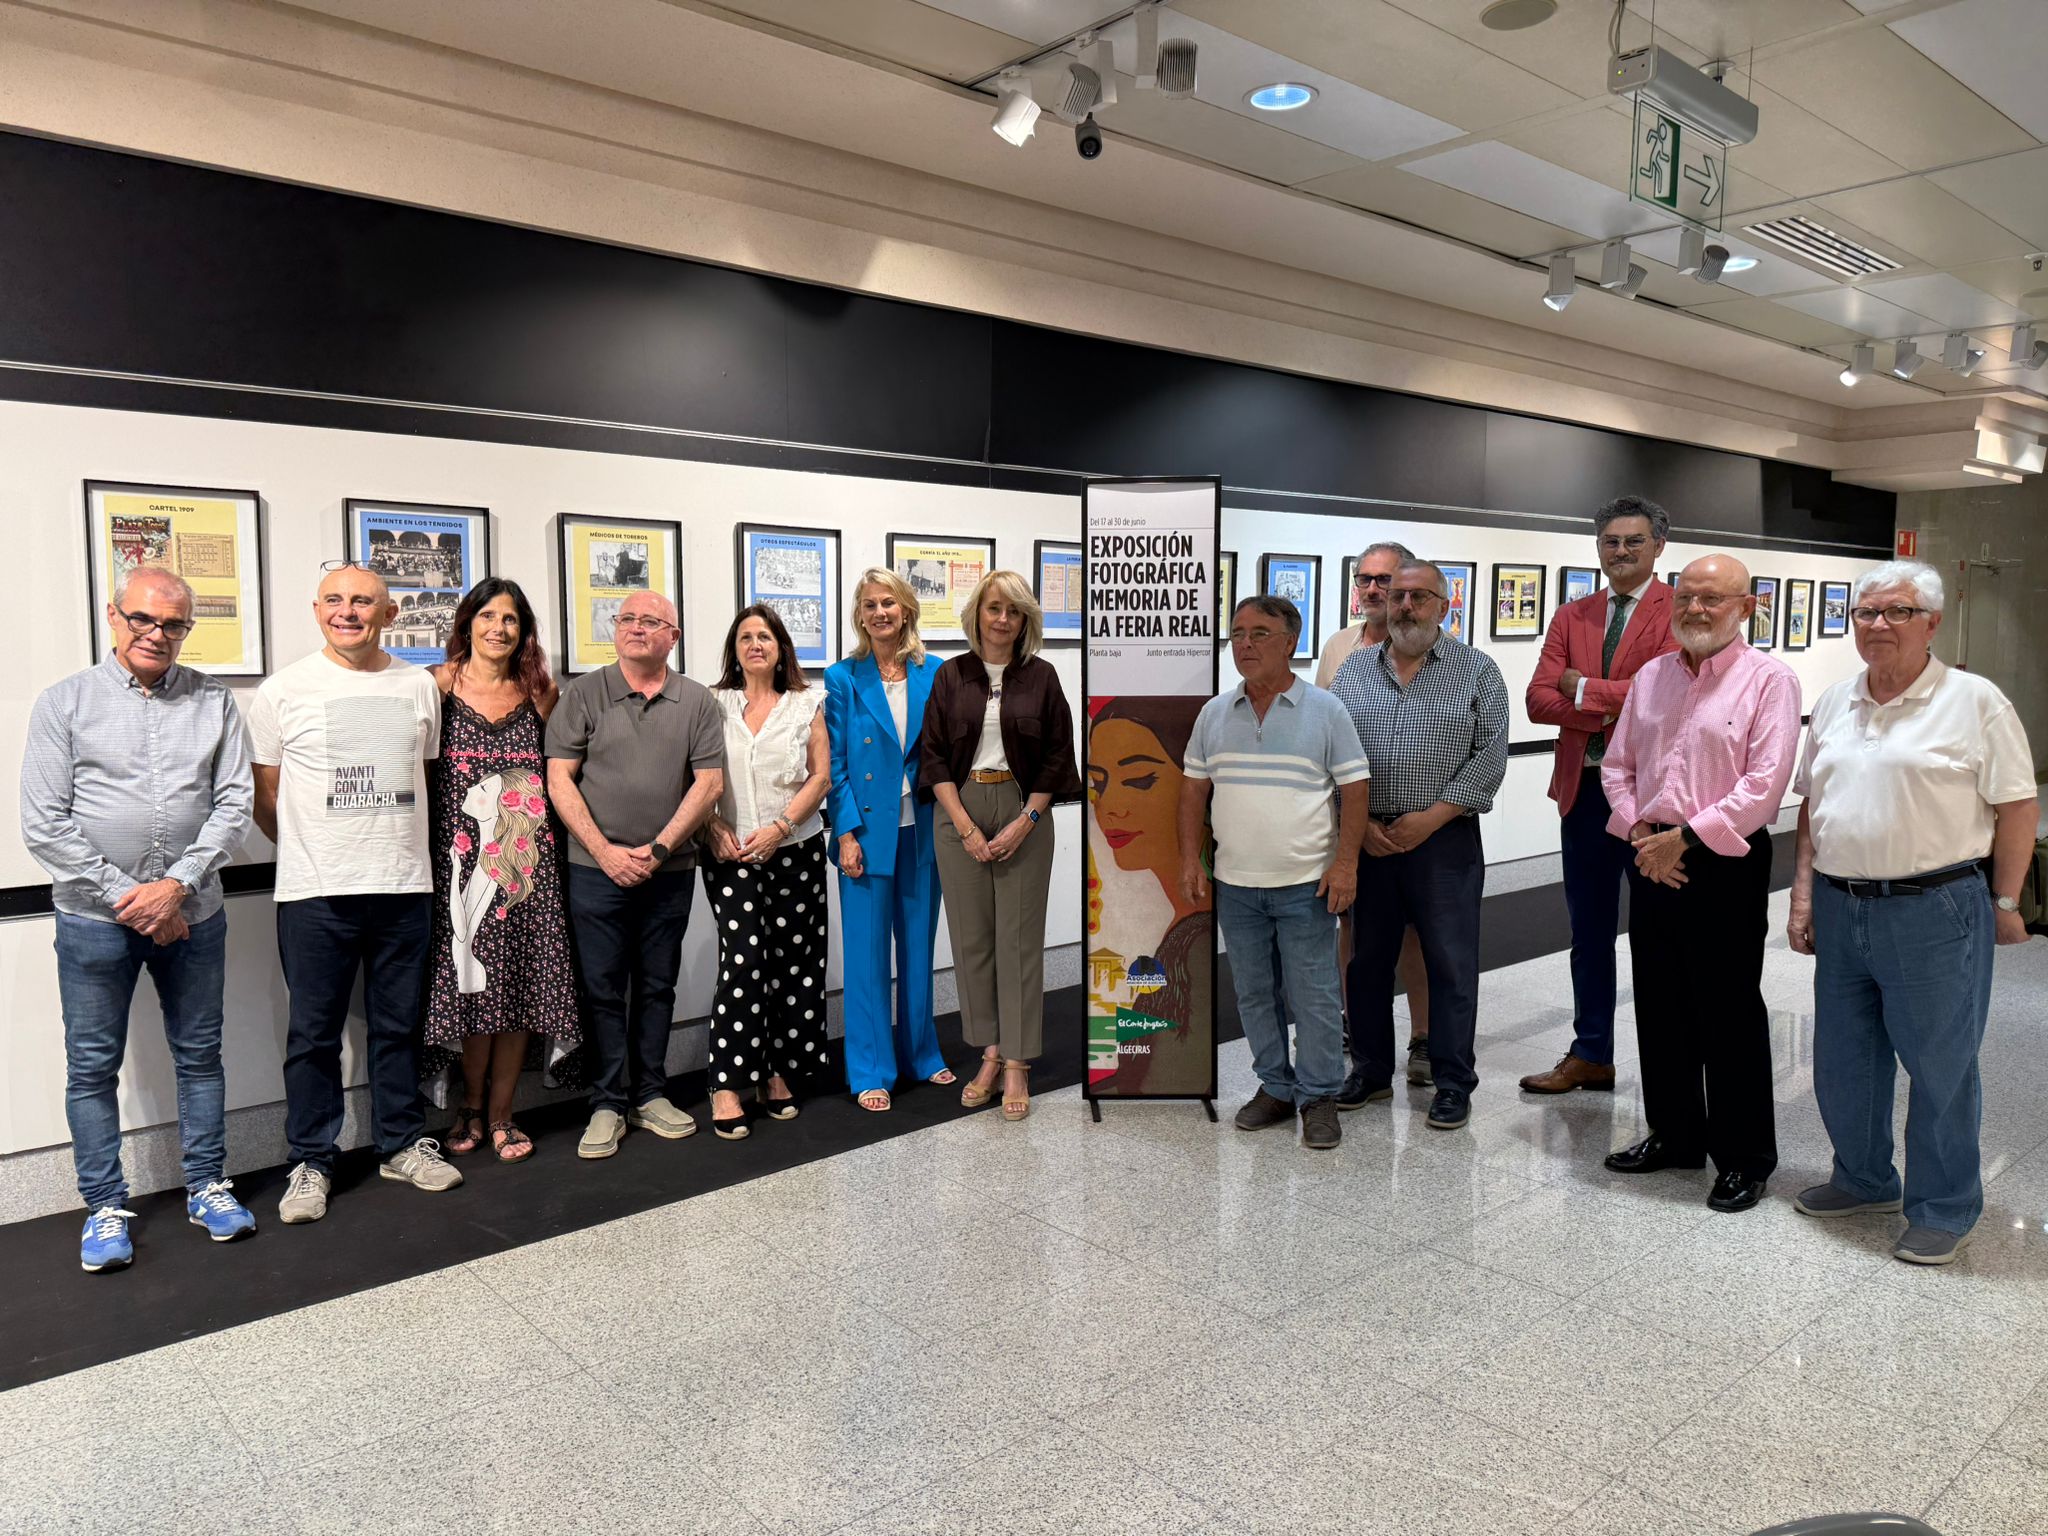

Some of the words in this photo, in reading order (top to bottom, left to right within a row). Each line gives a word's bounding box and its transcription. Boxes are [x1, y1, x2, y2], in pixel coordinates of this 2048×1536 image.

[149, 504, 178, 512] CARTEL
[367, 517, 403, 525] AMBIENTE
[1090, 517, 1099, 526] Del
[1101, 517, 1106, 526] 17
[1107, 517, 1113, 526] al
[1114, 517, 1121, 526] 30
[1123, 517, 1130, 526] de
[1130, 517, 1146, 527] junio
[1090, 531, 1193, 558] EXPOSICIÓN
[1090, 558, 1206, 585] FOTOGRÁFICA
[1090, 588, 1171, 611] MEMORIA
[1176, 588, 1198, 611] DE
[1090, 615, 1111, 638] LA
[1115, 615, 1164, 638] FERIA
[1169, 615, 1211, 637] REAL
[1089, 649, 1107, 657] Planta
[1109, 649, 1122, 658] baja
[1147, 648, 1162, 657] Junto
[1163, 648, 1185, 657] entrada
[1186, 648, 1211, 658] Hipercor
[335, 765, 375, 779] AVANTI
[335, 780, 357, 793] CON
[360, 780, 374, 793] LA
[333, 792, 397, 809] GUARACHA
[1118, 1019, 1125, 1027] El
[1125, 1018, 1143, 1028] Corte
[1115, 1044, 1151, 1054] ALGECIRAS
